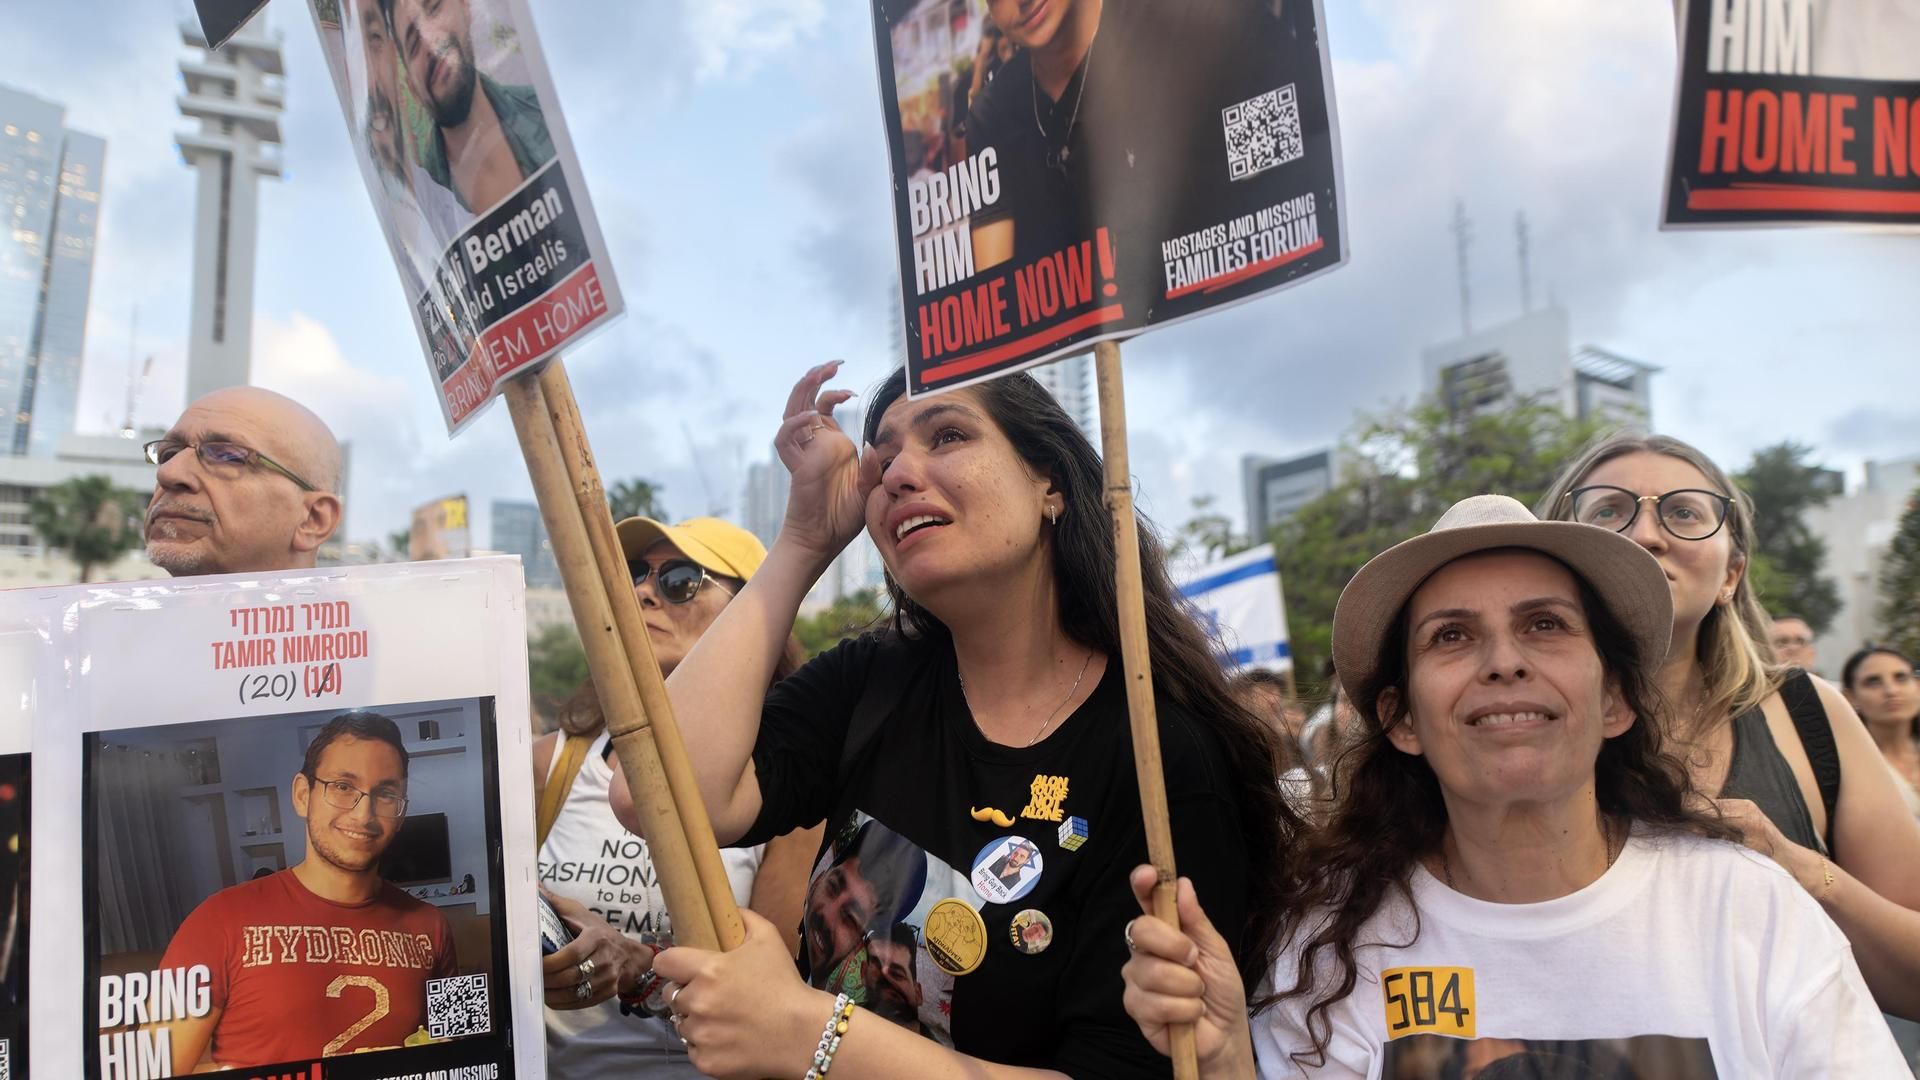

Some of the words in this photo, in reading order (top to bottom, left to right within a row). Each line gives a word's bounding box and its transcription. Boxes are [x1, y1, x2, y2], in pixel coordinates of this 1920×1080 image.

[1706, 0, 1810, 75] HIM
[1698, 89, 1857, 175] HOME
[907, 146, 1001, 237] BRING
[464, 186, 563, 274] Berman
[913, 218, 975, 296] HIM
[1161, 223, 1228, 263] HOSTAGES
[1228, 214, 1255, 242] AND
[1256, 192, 1316, 231] MISSING
[1164, 239, 1249, 292] FAMILIES
[1250, 213, 1319, 265] FORUM
[498, 238, 568, 300] Israelis
[918, 276, 1012, 360] HOME
[1014, 226, 1118, 328] NOW!
[532, 276, 605, 347] HOME
[229, 605, 295, 636] נמרודי
[300, 601, 351, 631] תמיר
[211, 637, 276, 670] TAMIR
[282, 630, 368, 664] NIMRODI
[239, 670, 297, 705] (20)
[601, 839, 651, 859] NO
[597, 888, 614, 902] to
[620, 888, 642, 904] be
[977, 880, 993, 898] Home
[242, 925, 434, 970] HYDRONIC
[98, 964, 211, 1029] BRING
[1384, 971, 1470, 1031] 584
[98, 1026, 172, 1080] HIM
